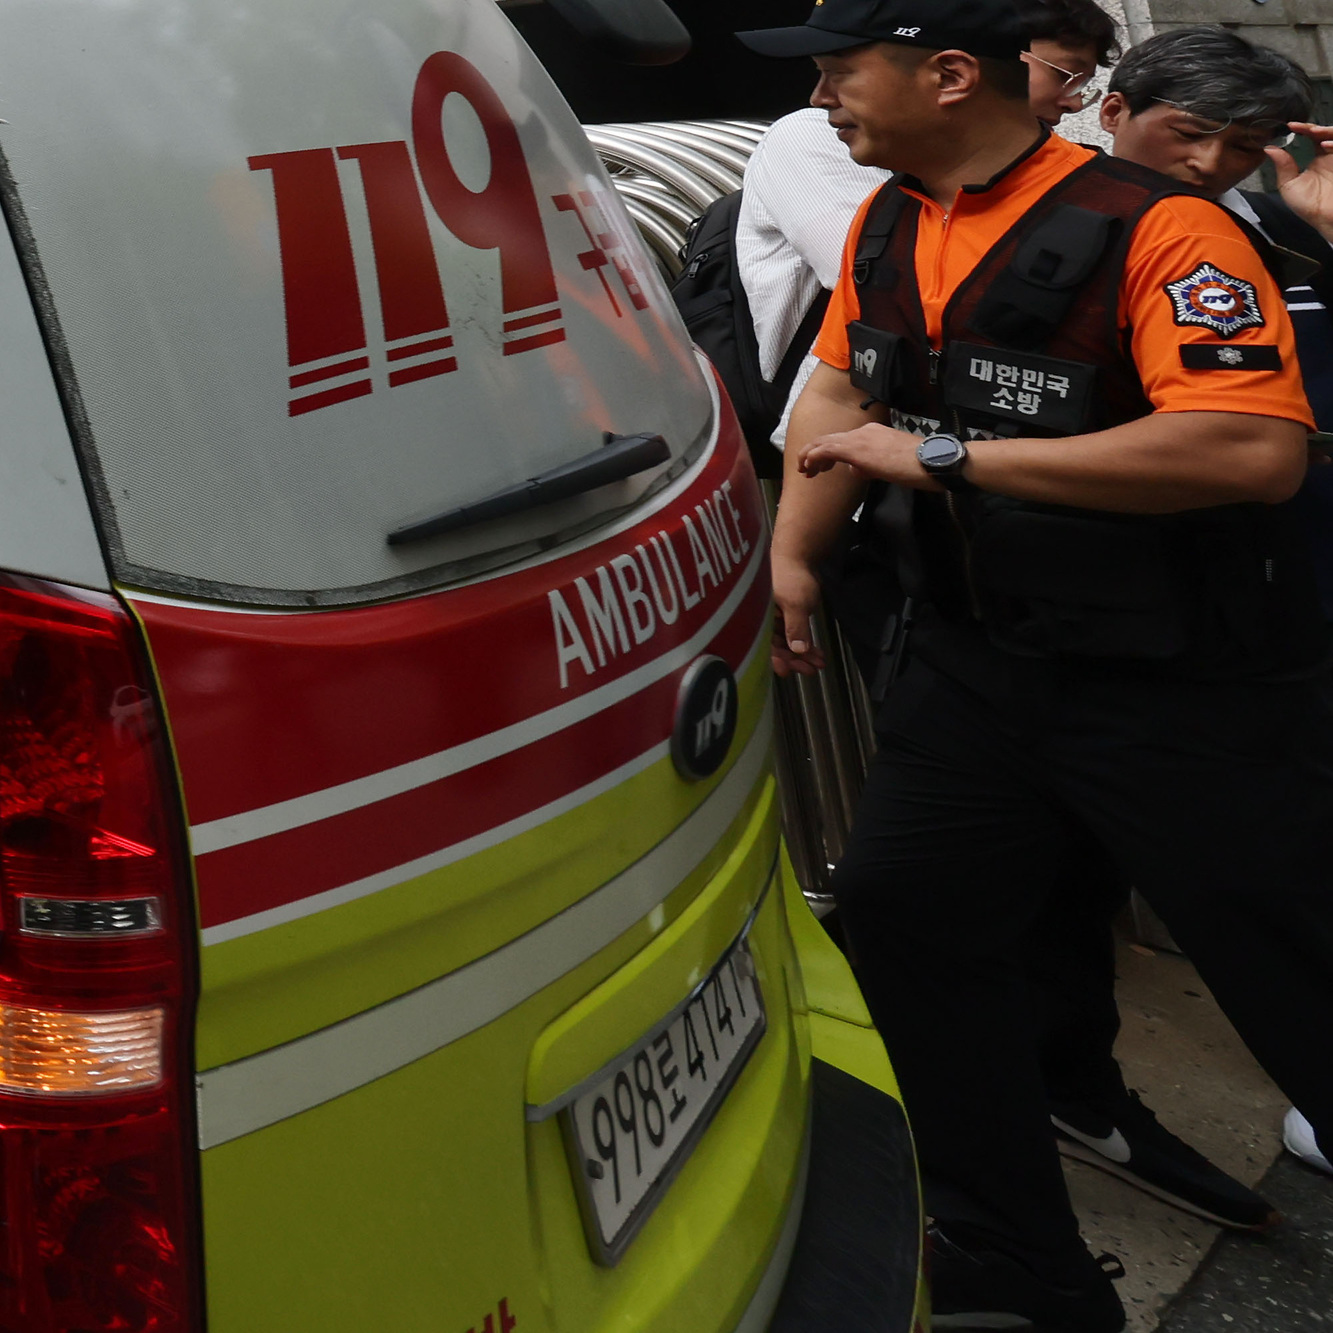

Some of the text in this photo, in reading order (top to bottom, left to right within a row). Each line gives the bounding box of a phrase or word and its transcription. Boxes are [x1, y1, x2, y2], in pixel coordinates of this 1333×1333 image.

[246, 50, 567, 418] 119
[854, 348, 877, 378] 119
[968, 357, 1071, 399] 대한민국
[989, 387, 1043, 416] 소방
[547, 479, 750, 690] AMBULANCE
[694, 677, 729, 758] 119
[592, 1030, 687, 1204] 998로
